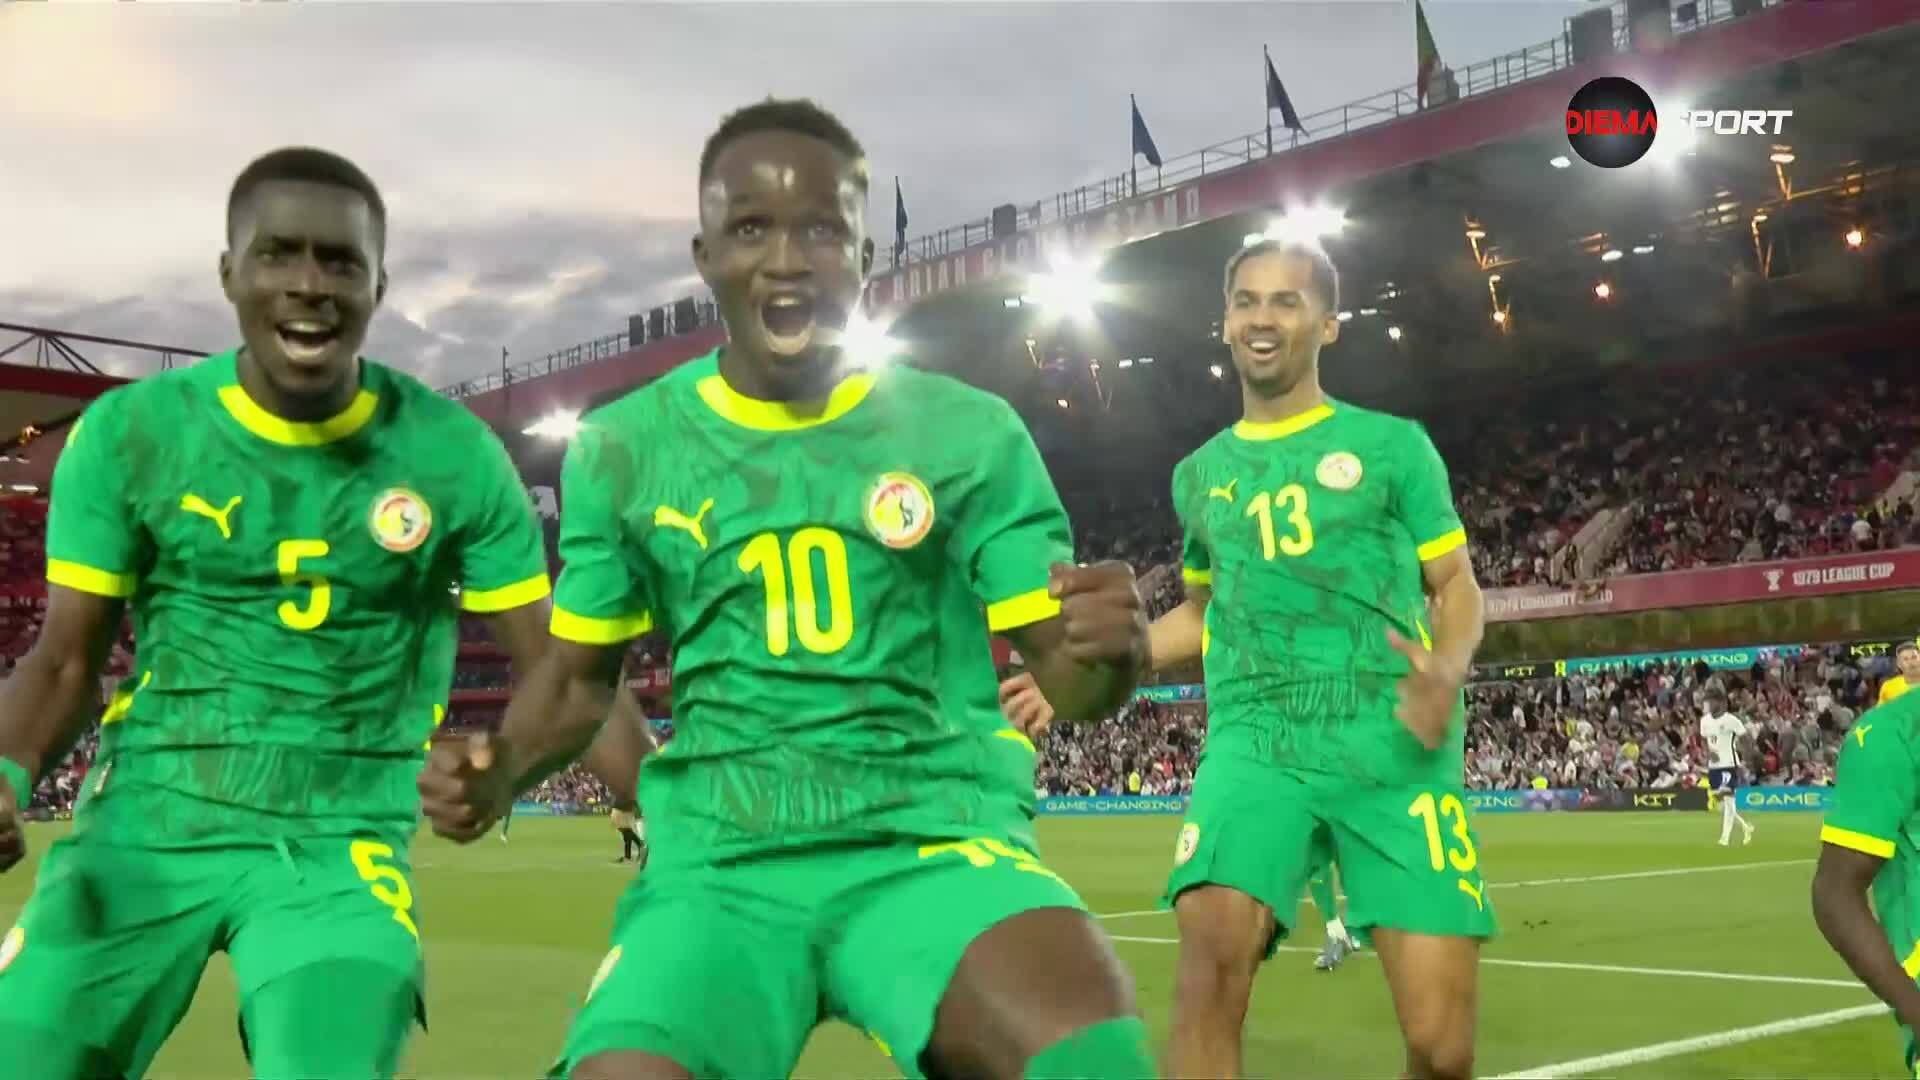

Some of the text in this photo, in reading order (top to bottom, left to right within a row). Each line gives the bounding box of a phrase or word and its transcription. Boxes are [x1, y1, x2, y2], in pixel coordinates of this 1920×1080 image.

[1247, 483, 1314, 561] 13
[277, 539, 331, 631] 5
[737, 527, 853, 656] 10
[1822, 565, 1868, 583] LEAGUE
[1869, 562, 1895, 579] CUP
[1504, 666, 1536, 677] KIT
[1408, 792, 1477, 872] 13
[1633, 793, 1678, 807] KIT
[350, 840, 413, 910] 5
